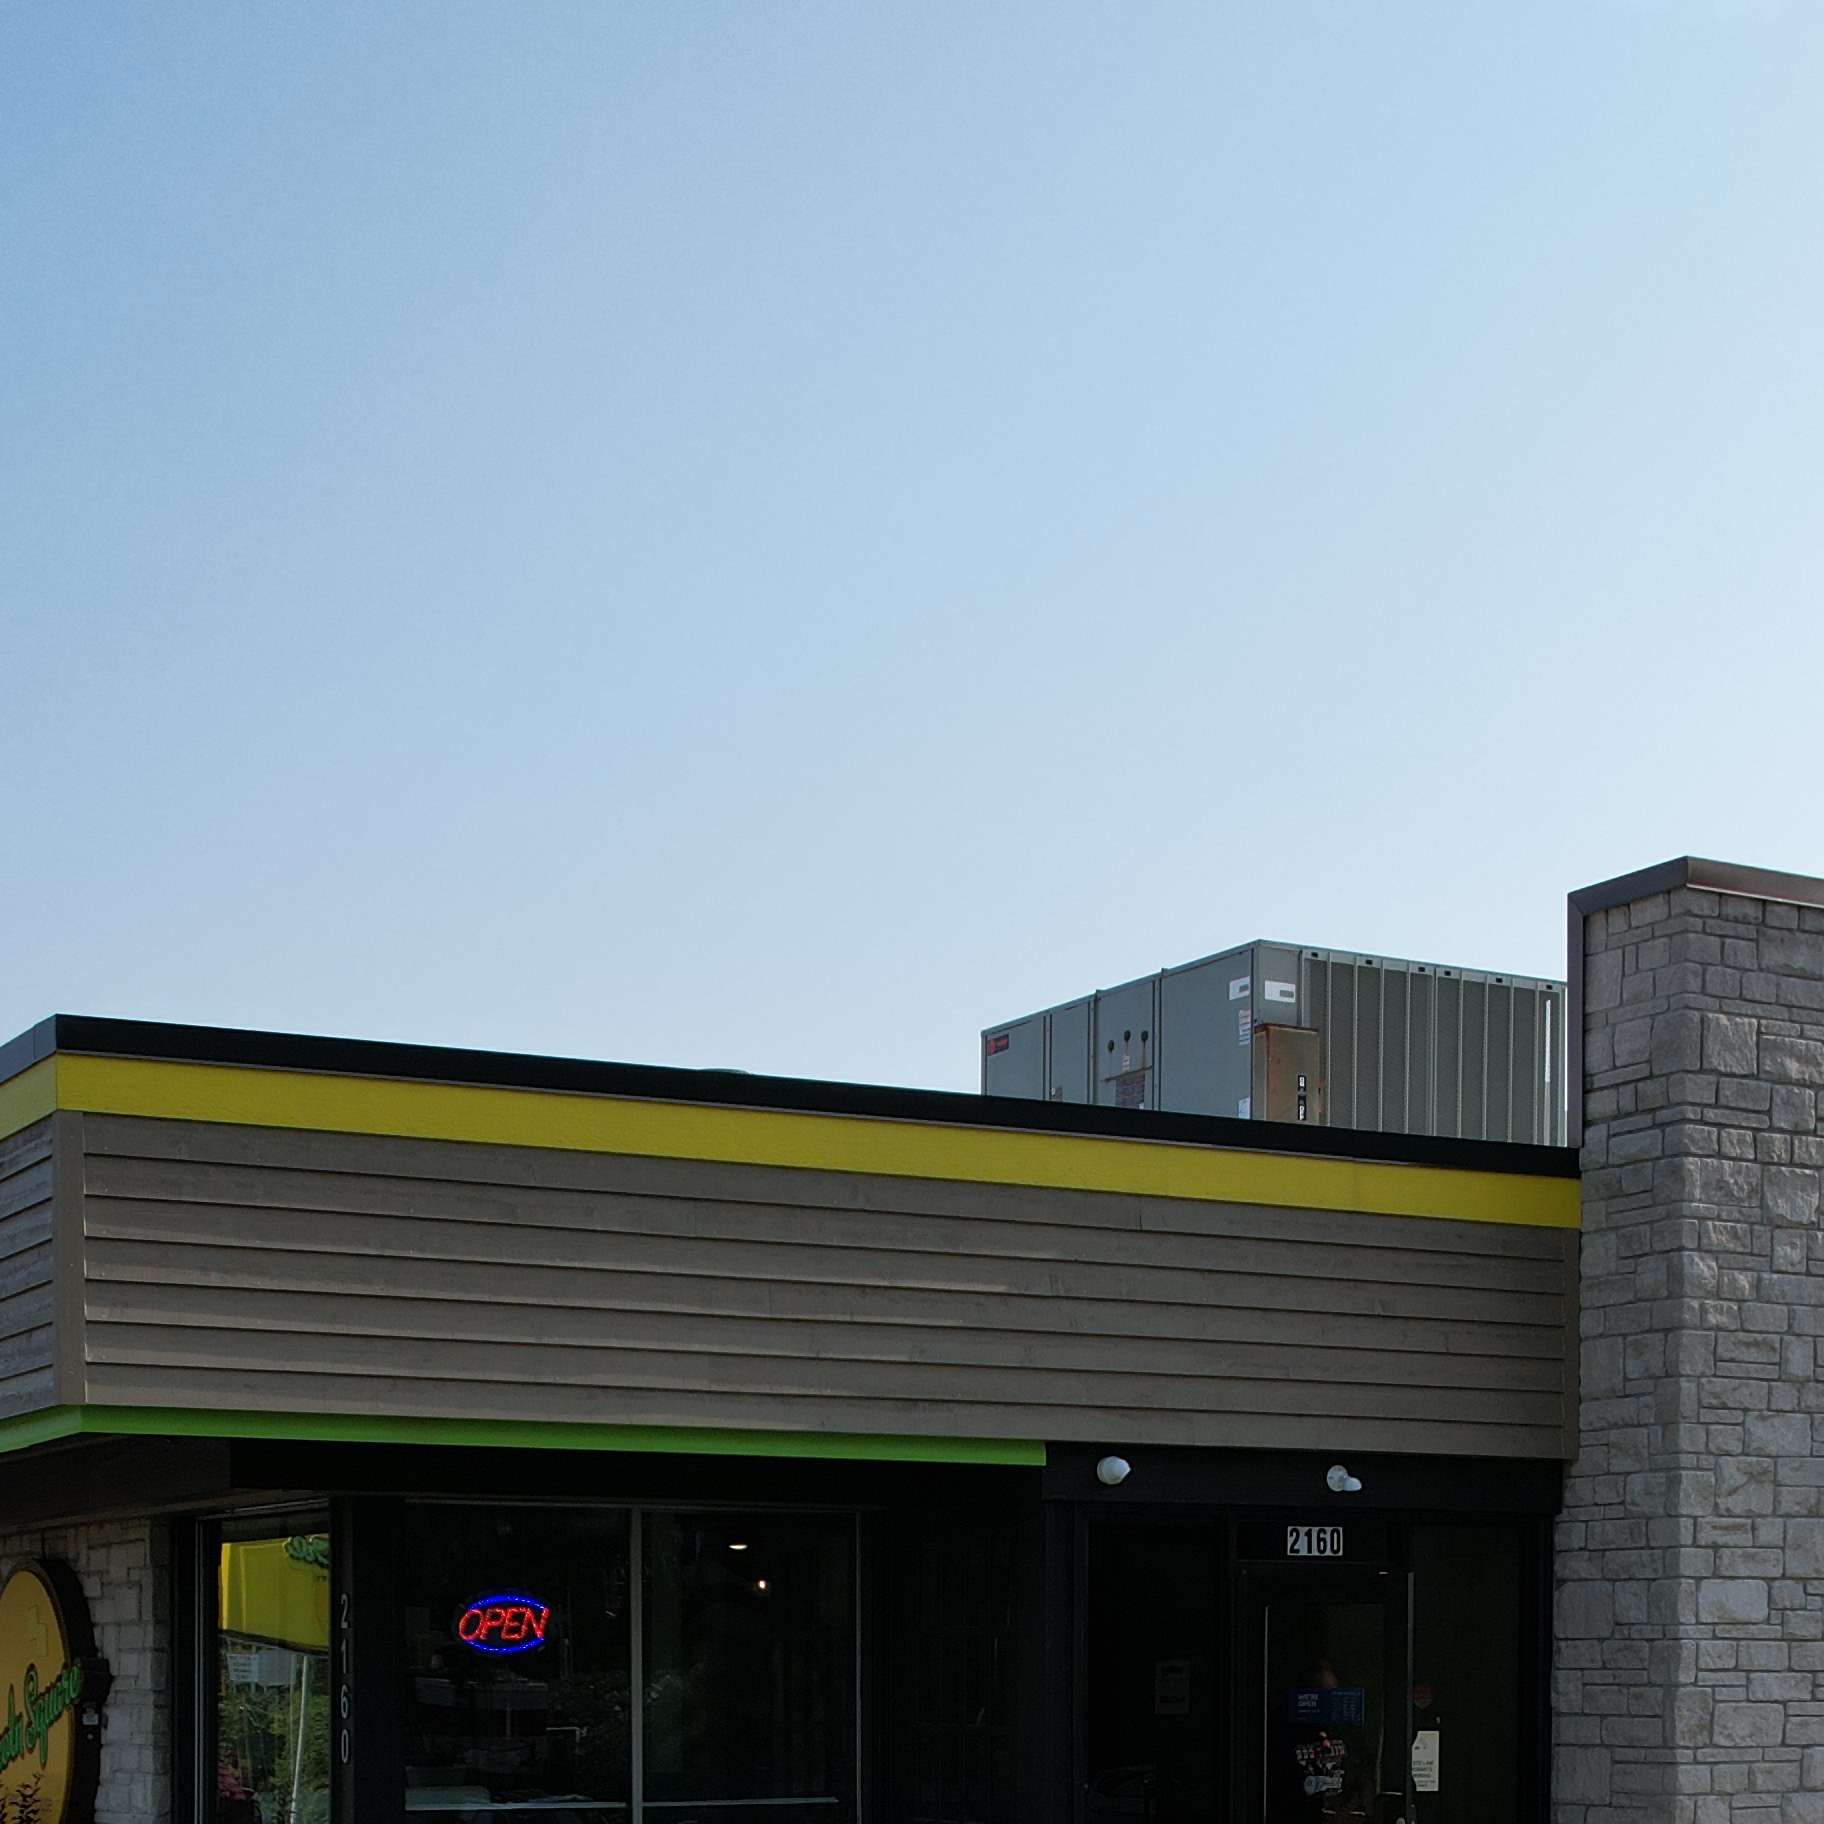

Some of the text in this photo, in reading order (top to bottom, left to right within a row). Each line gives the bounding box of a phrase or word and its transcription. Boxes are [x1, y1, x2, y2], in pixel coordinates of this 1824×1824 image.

[1288, 1527, 1342, 1555] 2160
[458, 1606, 551, 1641] OPEN
[24, 1665, 85, 1769] Square
